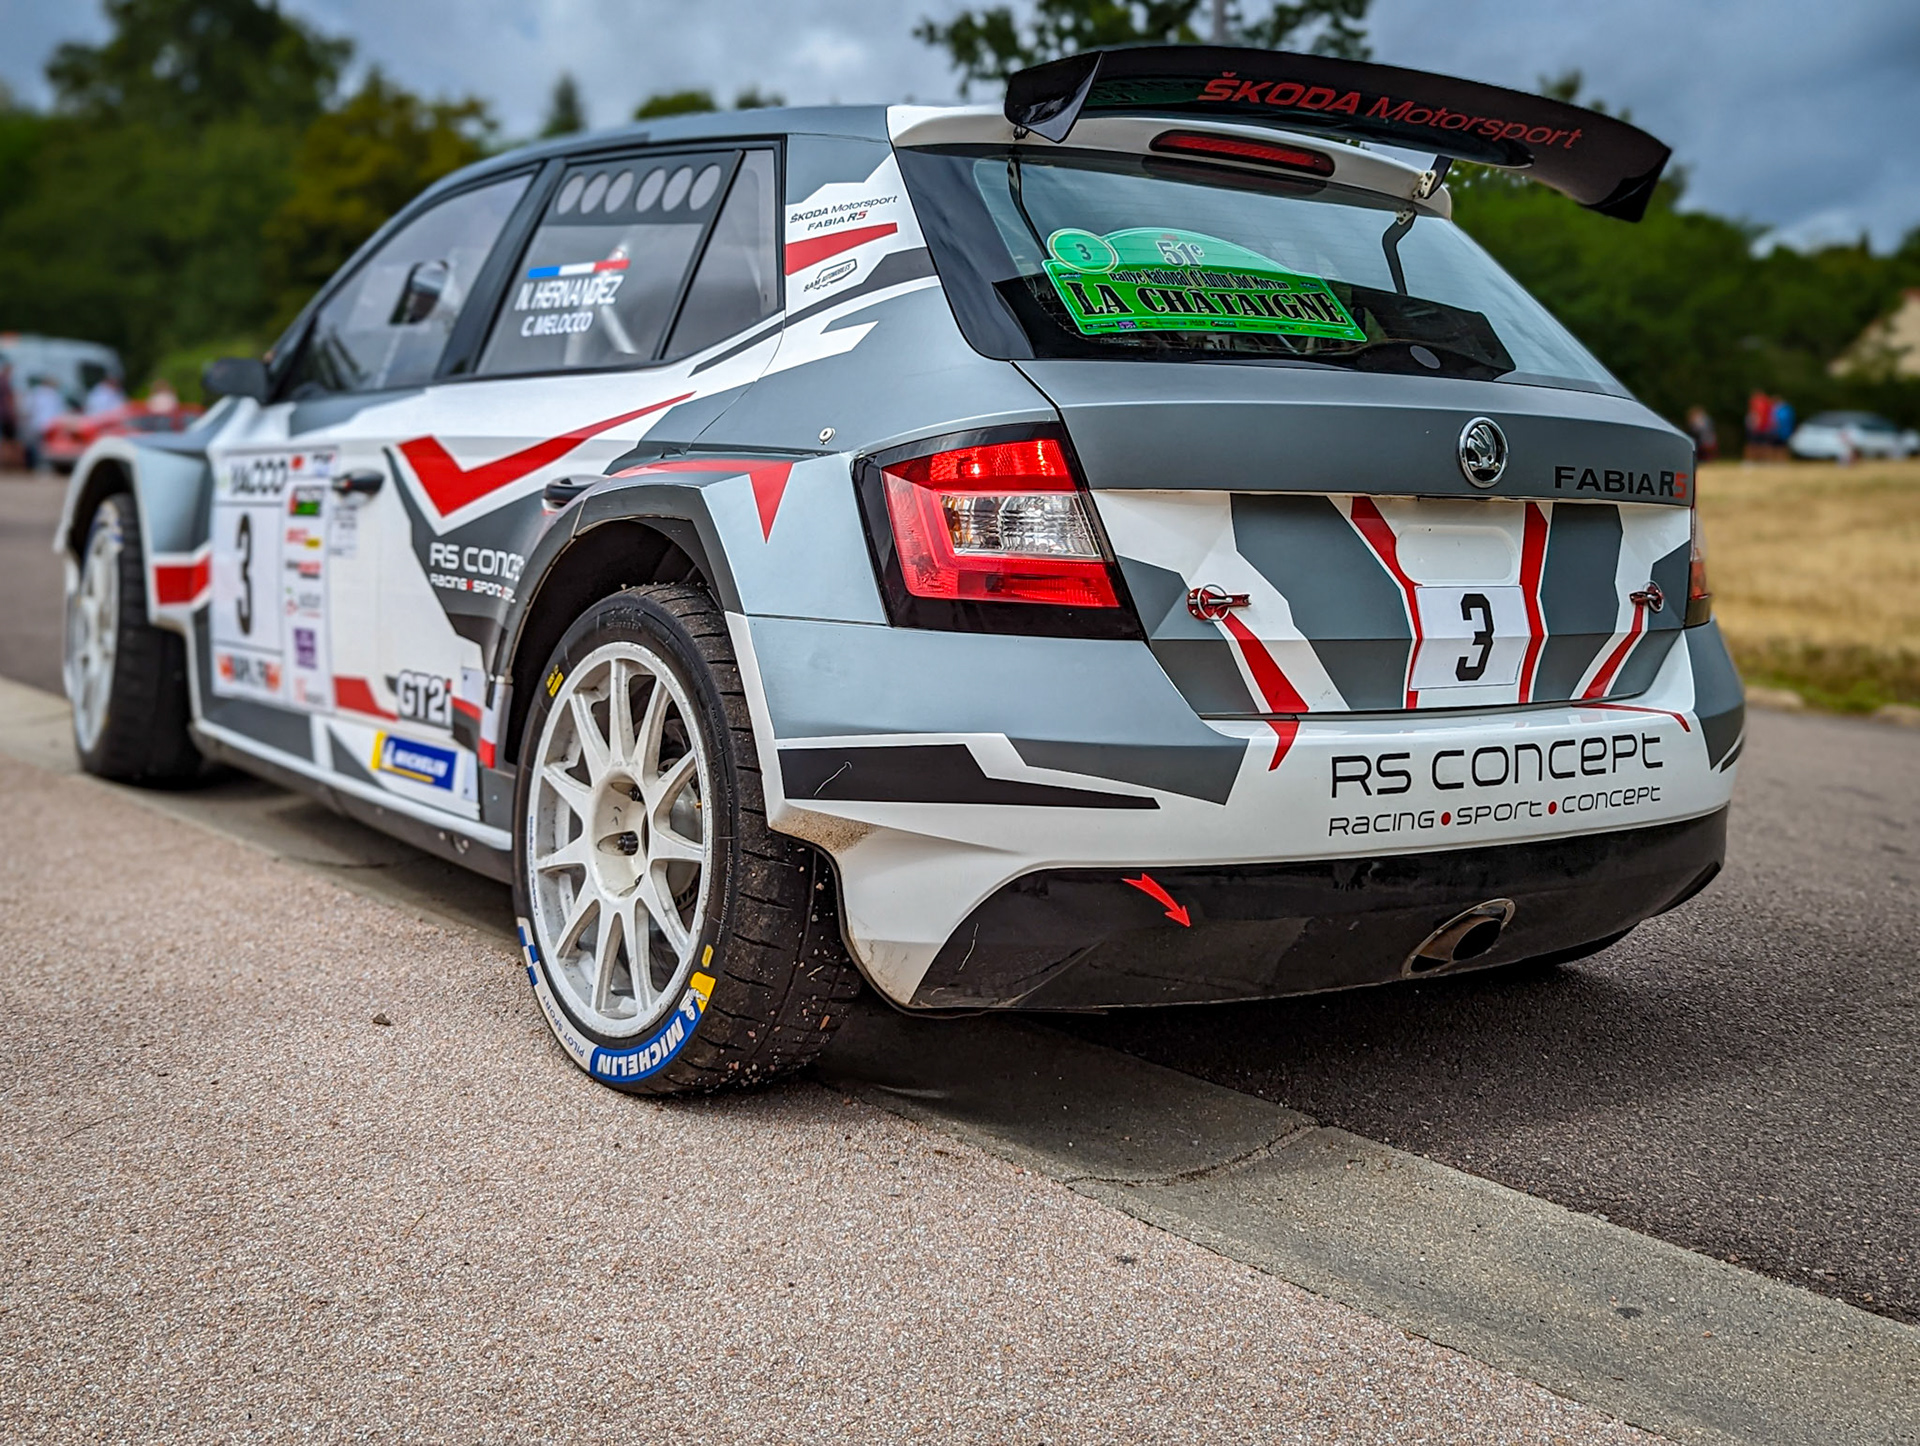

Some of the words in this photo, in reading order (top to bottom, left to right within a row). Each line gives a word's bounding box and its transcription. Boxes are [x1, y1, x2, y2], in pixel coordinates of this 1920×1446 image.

[1198, 72, 1361, 115] ŠKODA
[1366, 96, 1582, 150] Motorsport
[790, 207, 829, 223] ŠKODA
[831, 195, 898, 214] Motorsport
[807, 217, 846, 231] FABIA
[1076, 243, 1092, 261] 3
[531, 275, 624, 310] HERNANDEZ
[804, 278, 821, 292] SAM
[1109, 269, 1146, 284] Rallye
[1143, 267, 1191, 287] National
[1227, 272, 1255, 290] Sud
[1250, 276, 1291, 290] Morvan
[1065, 281, 1134, 315] LA
[1136, 286, 1348, 325] CHÂTAIGNE
[1554, 466, 1655, 497] FABIA
[430, 542, 460, 570] RS
[235, 514, 253, 636] 3
[1455, 593, 1495, 681] 3
[1331, 752, 1412, 798] RS
[542, 995, 563, 1031] SPORT
[563, 1033, 585, 1058] PILOT
[597, 1016, 685, 1077] MICHELIN
